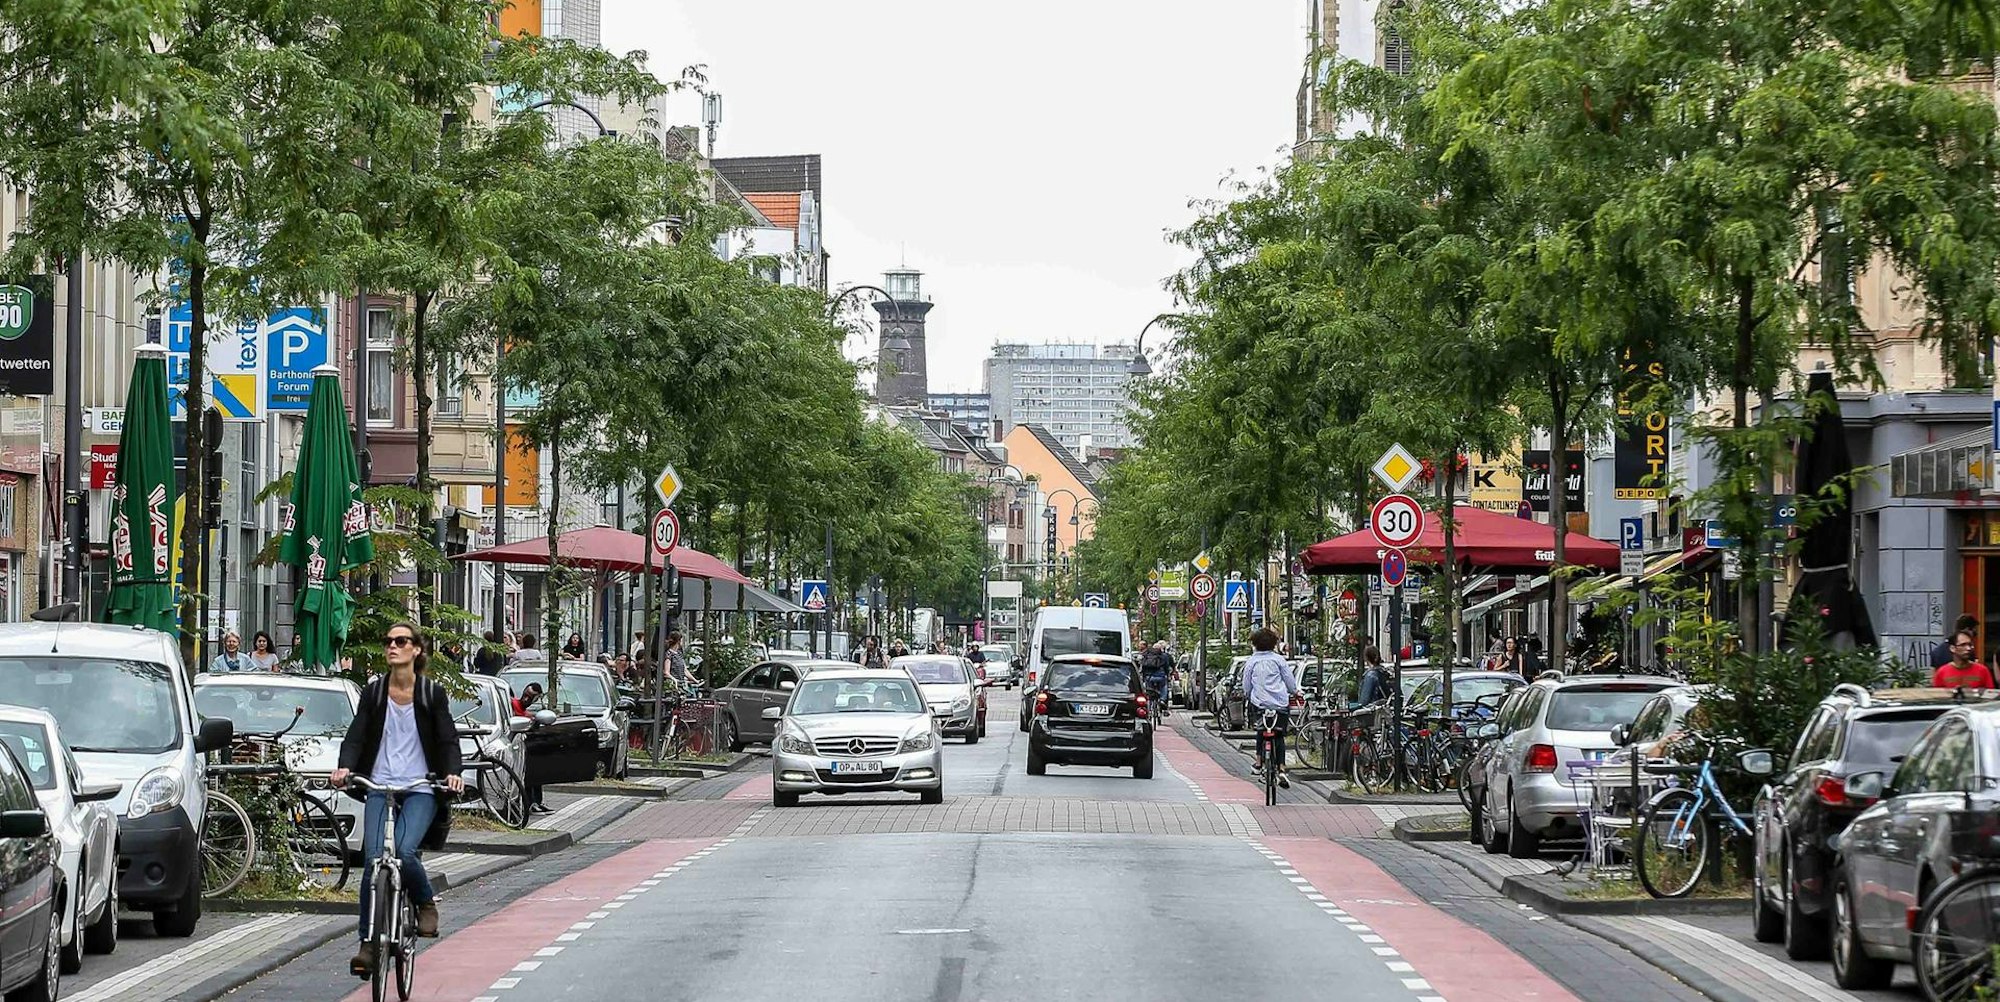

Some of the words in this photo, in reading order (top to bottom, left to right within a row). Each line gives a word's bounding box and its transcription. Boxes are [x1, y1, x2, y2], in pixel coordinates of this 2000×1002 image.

[0, 305, 22, 328] 90
[283, 331, 309, 367] P
[0, 359, 50, 370] twetten
[278, 382, 309, 391] Forum
[1646, 362, 1666, 480] SORT
[92, 453, 117, 462] Studi
[1617, 489, 1655, 497] DEPO
[1383, 511, 1411, 533] 30
[658, 522, 673, 542] 30
[1624, 522, 1636, 549] P
[1196, 581, 1210, 590] 30
[1148, 588, 1158, 597] 30
[840, 763, 850, 771] OP
